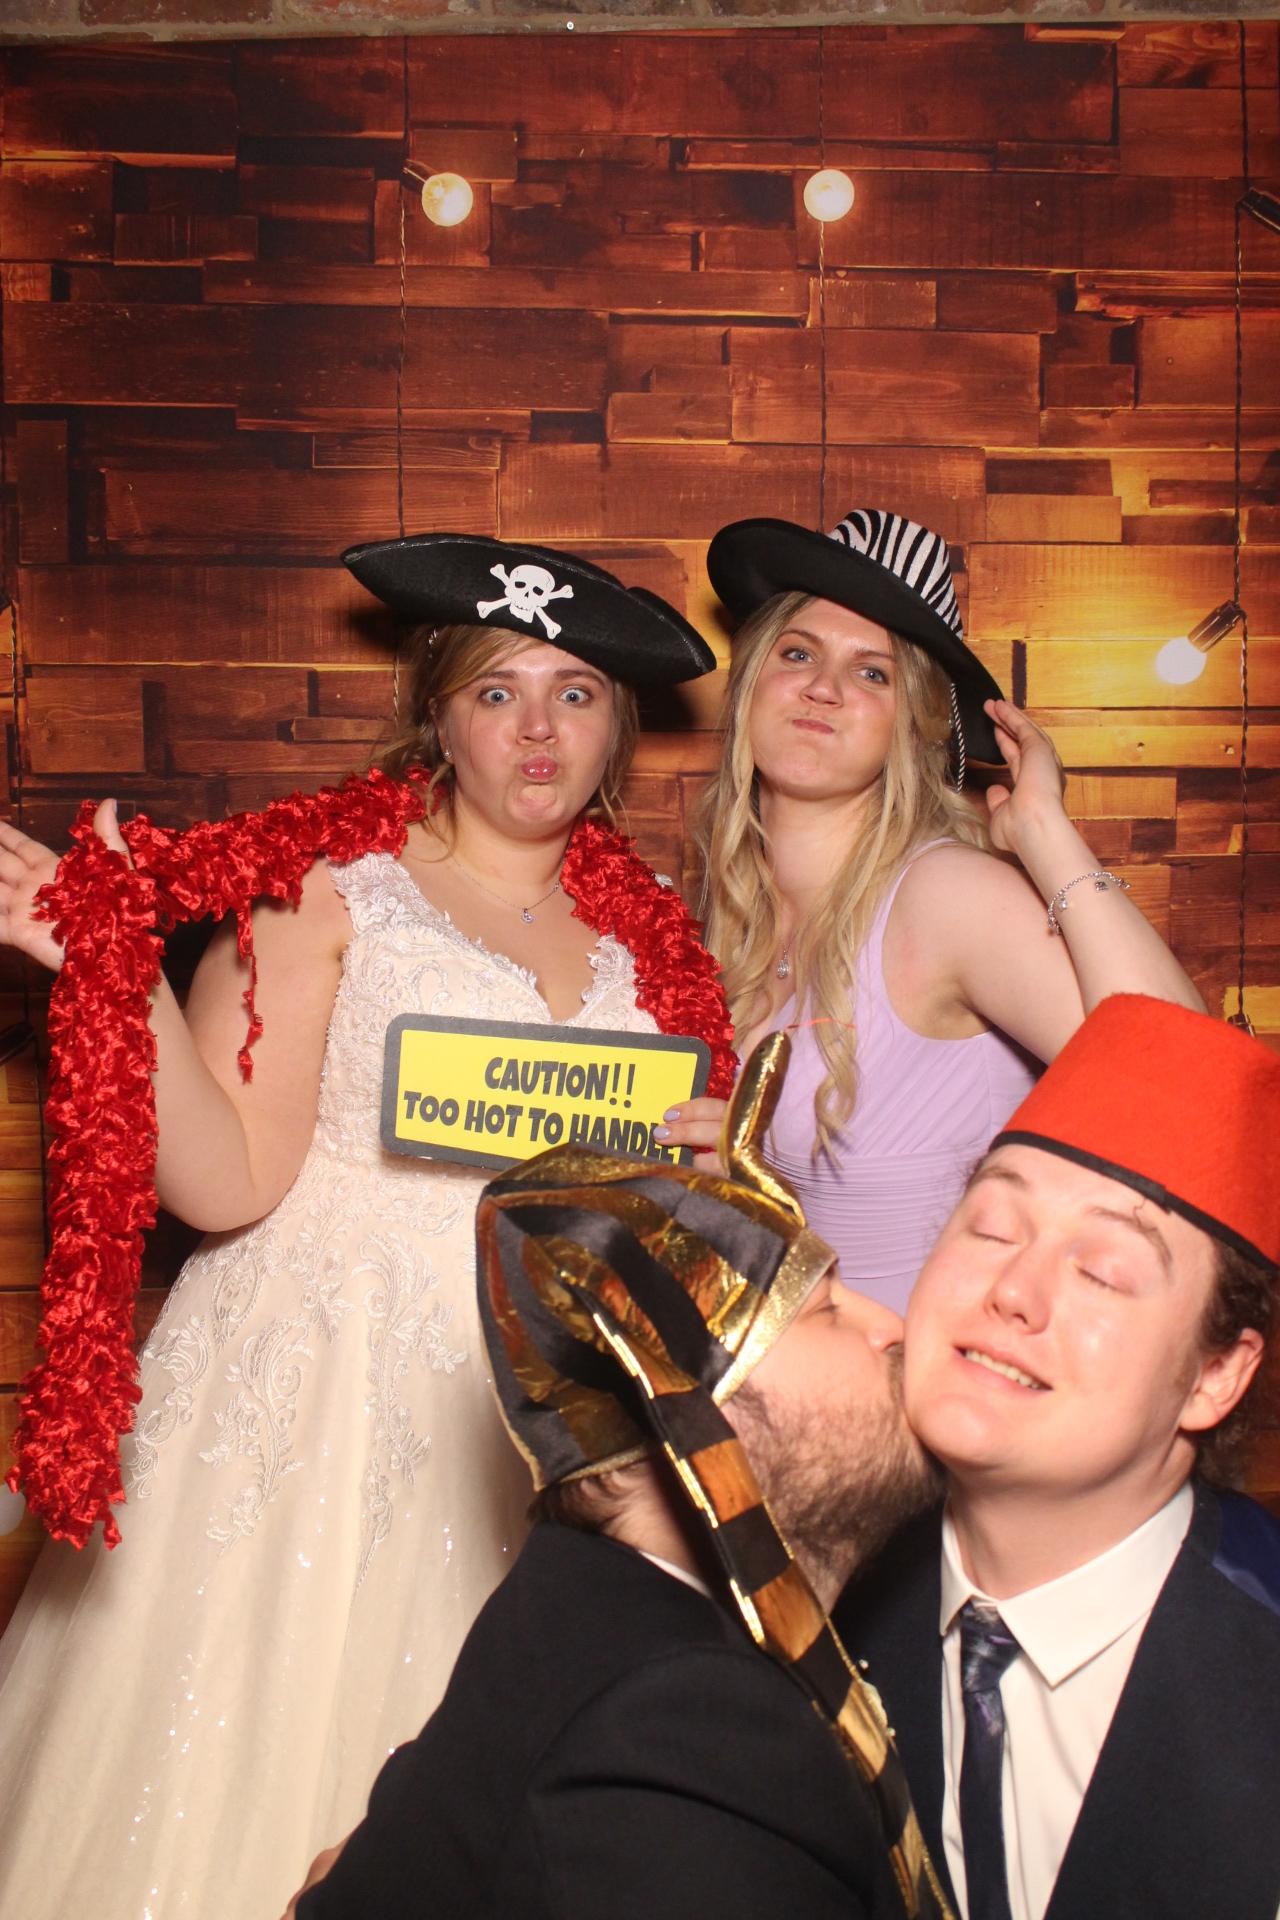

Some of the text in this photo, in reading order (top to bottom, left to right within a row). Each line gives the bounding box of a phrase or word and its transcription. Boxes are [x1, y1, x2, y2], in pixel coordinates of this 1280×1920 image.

[485, 1057, 635, 1108] CAUTION!!
[404, 1091, 459, 1126] TOO
[464, 1099, 523, 1137] HOT
[528, 1107, 563, 1144] TO
